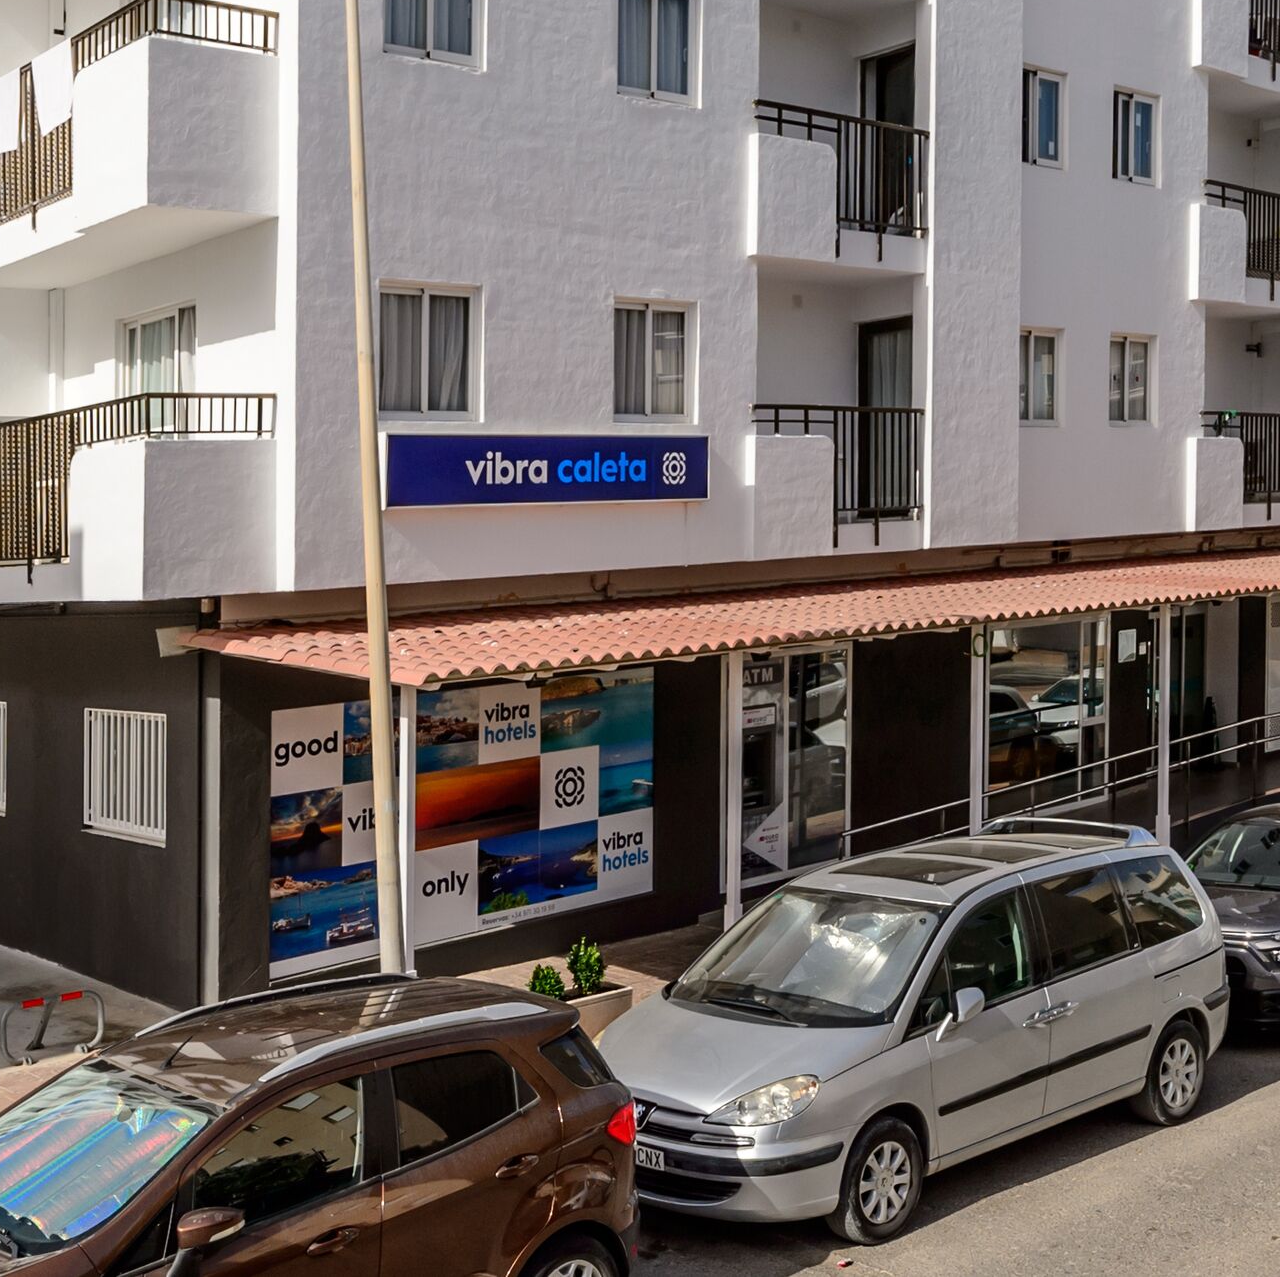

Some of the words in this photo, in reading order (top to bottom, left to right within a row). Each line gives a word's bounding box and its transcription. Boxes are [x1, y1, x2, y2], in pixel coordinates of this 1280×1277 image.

[465, 451, 549, 485] vibra
[557, 451, 646, 483] caleta
[743, 667, 774, 684] ATM
[484, 703, 530, 723] vibra
[484, 721, 537, 745] hotels
[274, 730, 338, 767] good
[602, 831, 643, 852] vibra
[602, 846, 649, 873] hotels
[422, 870, 470, 897] only
[637, 1147, 662, 1169] CNX
